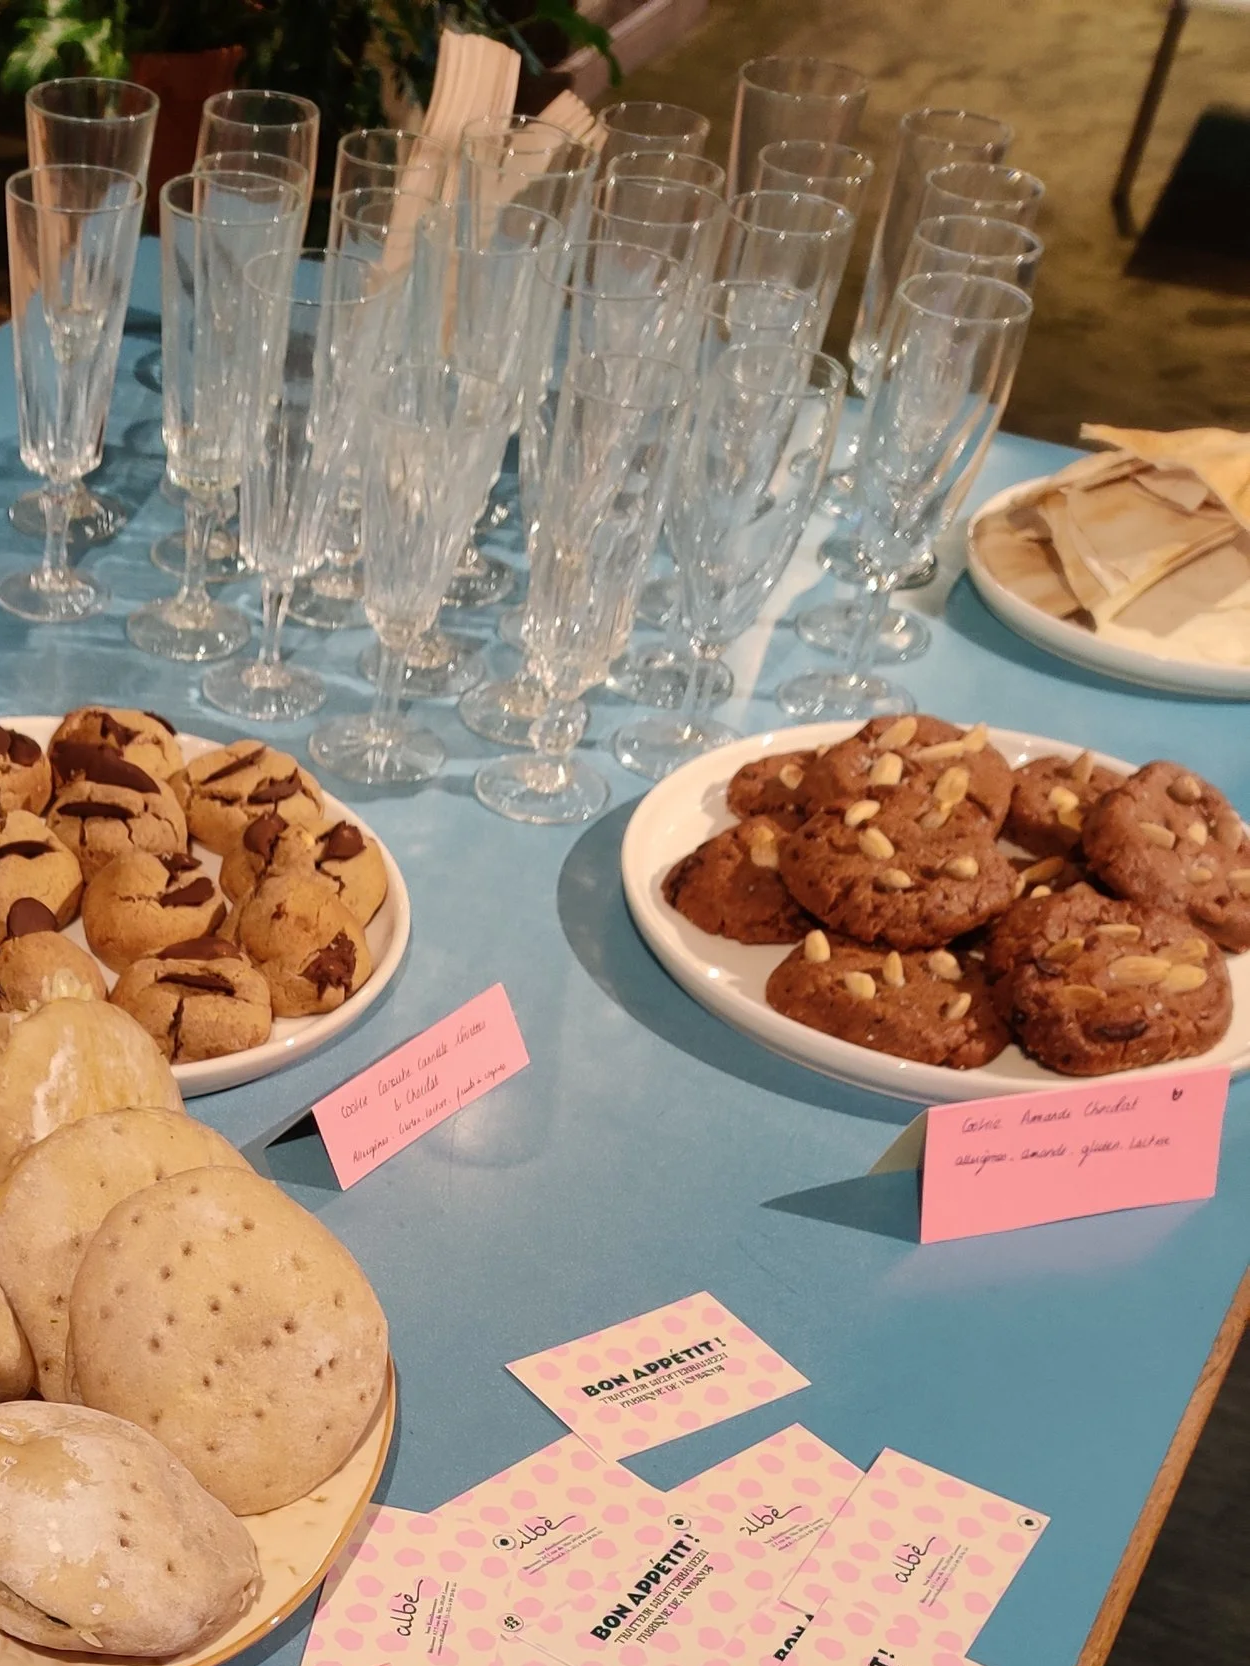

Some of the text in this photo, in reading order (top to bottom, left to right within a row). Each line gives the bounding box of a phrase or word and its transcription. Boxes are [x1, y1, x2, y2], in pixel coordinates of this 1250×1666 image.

[582, 1373, 630, 1398] BON
[633, 1340, 715, 1380] APPÉTIT
[590, 1603, 633, 1641] BON
[627, 1540, 692, 1607] APPÉTIT
